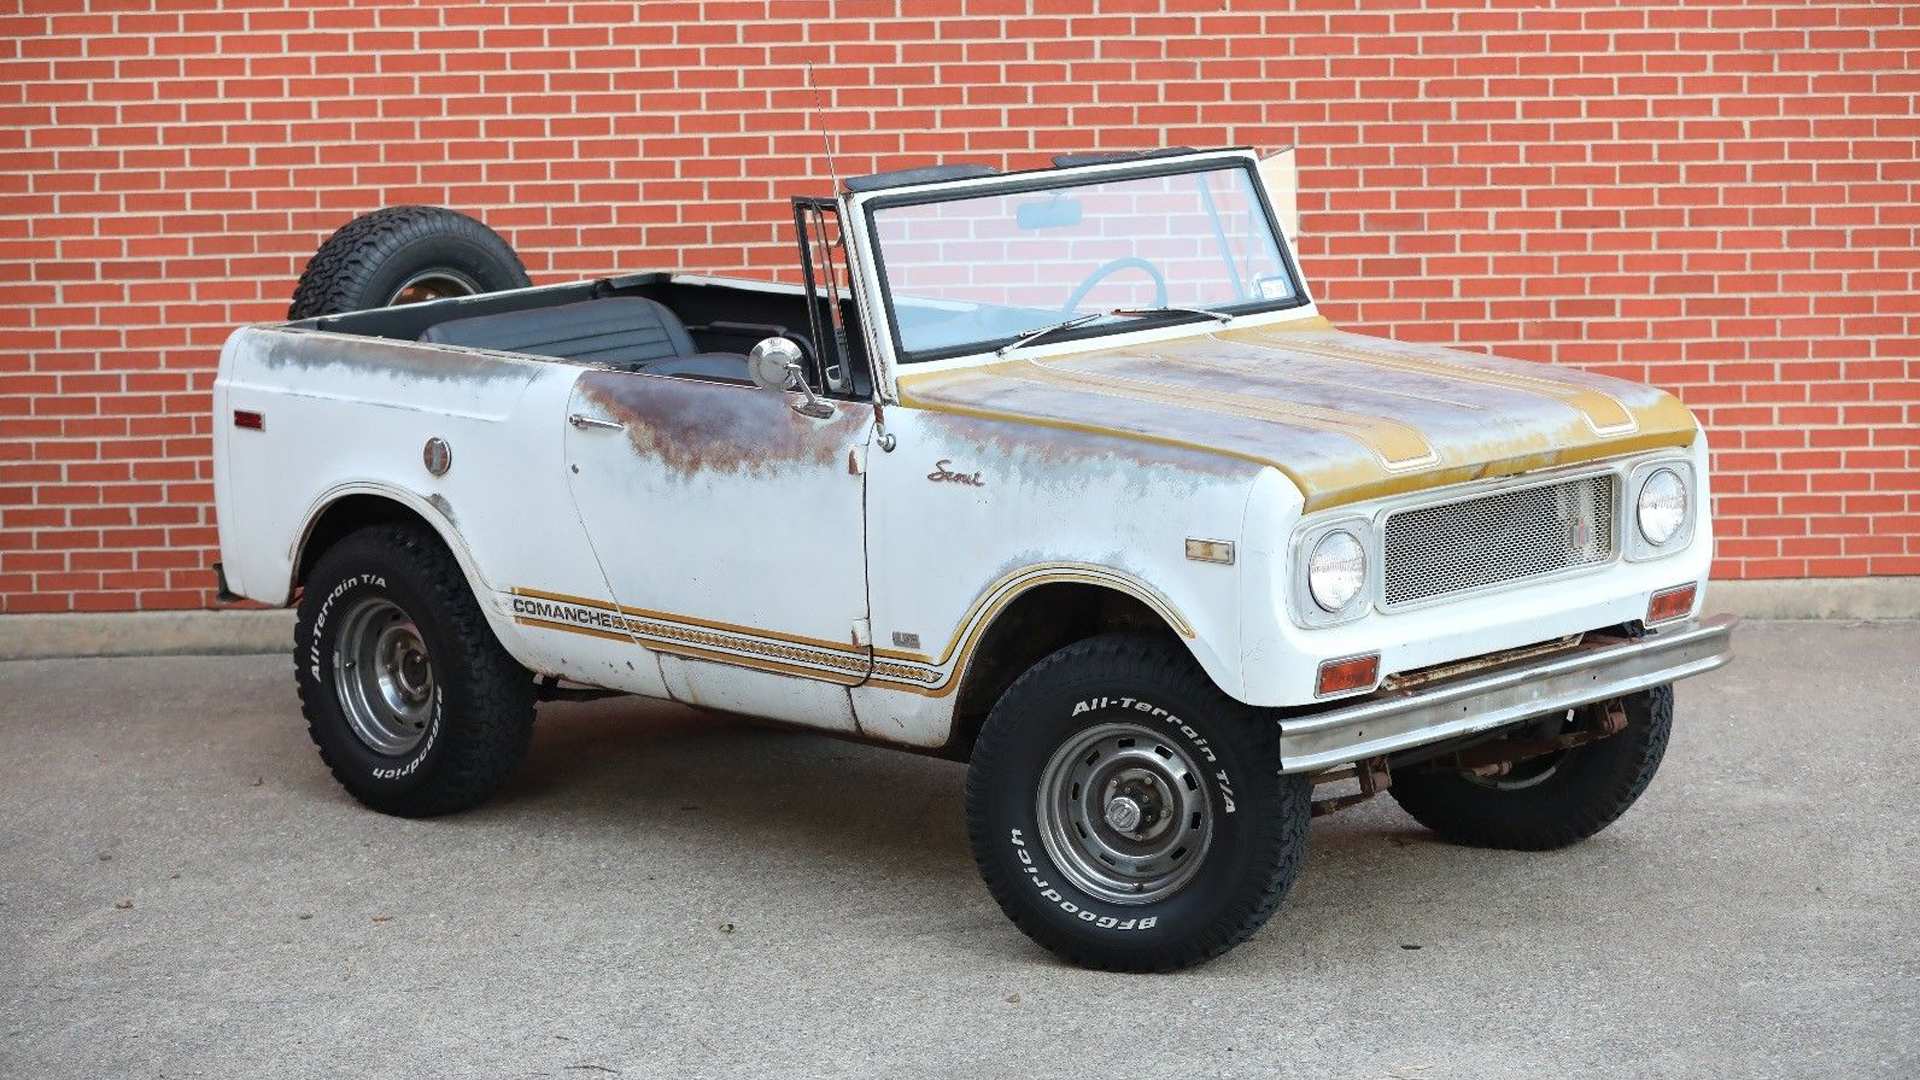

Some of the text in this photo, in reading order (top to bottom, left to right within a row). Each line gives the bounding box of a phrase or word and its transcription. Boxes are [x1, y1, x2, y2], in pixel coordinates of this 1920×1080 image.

[927, 459, 985, 487] Scout
[310, 574, 387, 683] All-Terrain T/A
[513, 598, 612, 628] COMANCHE
[1071, 697, 1236, 813] All-Terrain T/A
[1011, 828, 1158, 930] BFGoodrich
